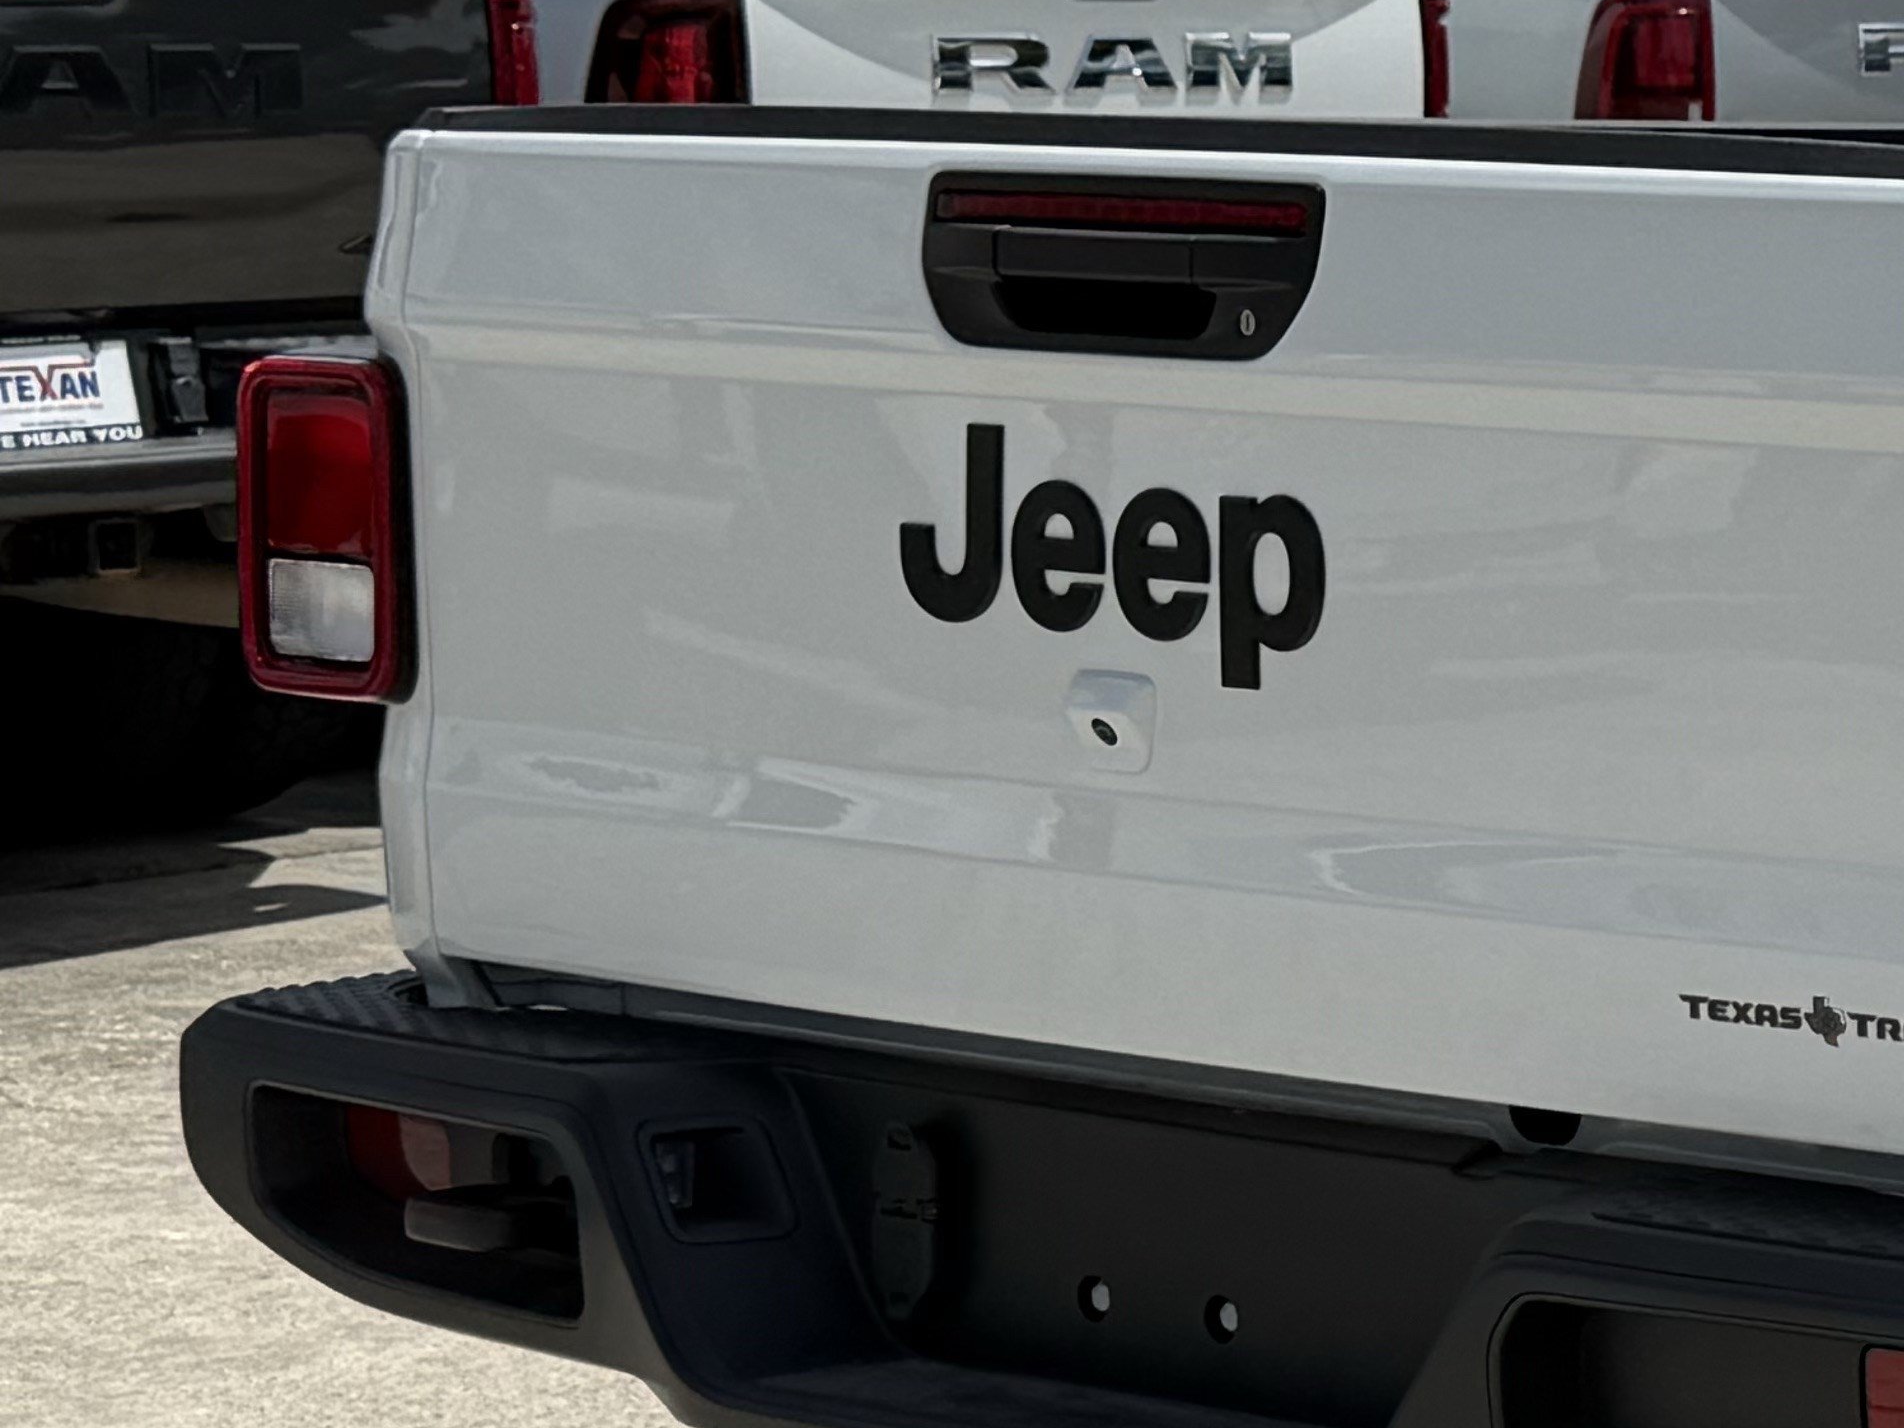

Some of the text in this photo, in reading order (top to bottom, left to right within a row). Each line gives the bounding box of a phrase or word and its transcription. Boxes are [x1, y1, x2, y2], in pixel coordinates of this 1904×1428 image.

[0, 43, 303, 118] AM
[932, 32, 1294, 95] RAM
[0, 366, 101, 403] TEXAN
[93, 425, 143, 442] YOU
[900, 422, 1326, 690] Jeep
[1679, 994, 1802, 1030] TEXAS
